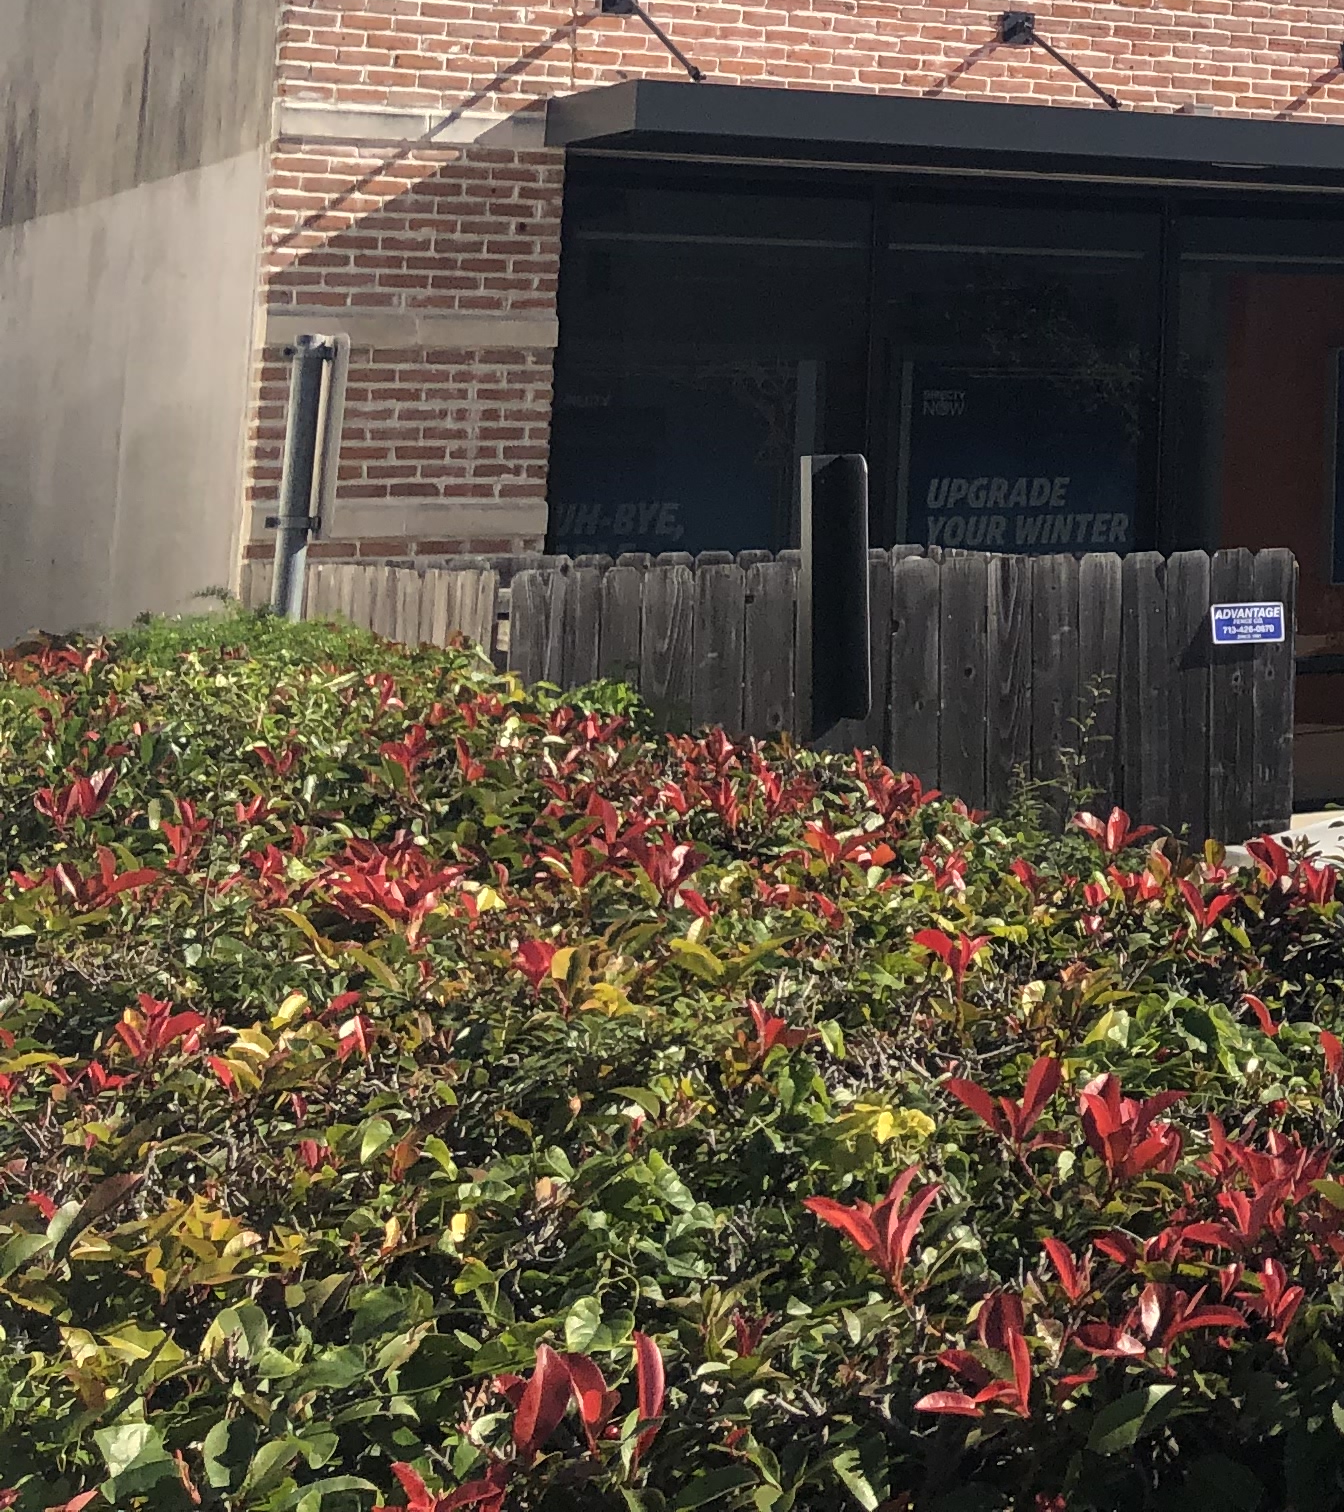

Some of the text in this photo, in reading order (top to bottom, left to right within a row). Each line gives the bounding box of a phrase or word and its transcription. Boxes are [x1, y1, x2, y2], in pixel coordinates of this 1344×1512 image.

[923, 400, 968, 416] NOW
[926, 476, 1071, 509] UPGRADE
[927, 512, 1130, 547] YOUR WINTER
[1215, 606, 1280, 619] ADVANTAGE
